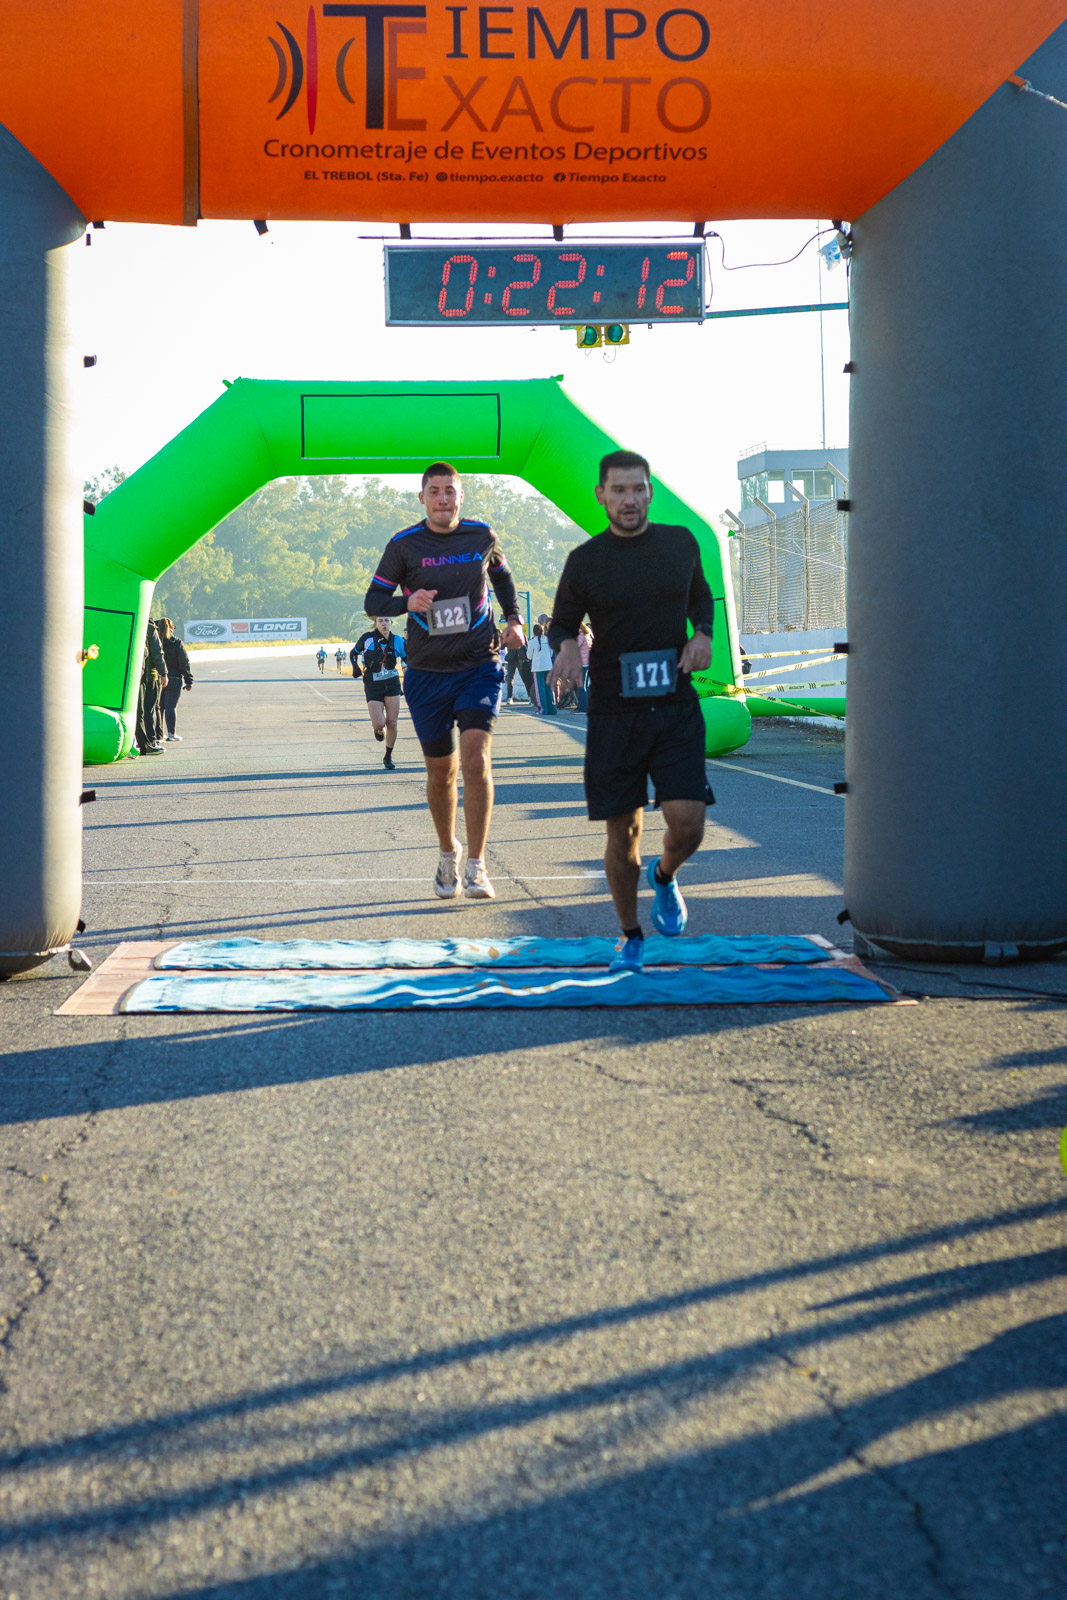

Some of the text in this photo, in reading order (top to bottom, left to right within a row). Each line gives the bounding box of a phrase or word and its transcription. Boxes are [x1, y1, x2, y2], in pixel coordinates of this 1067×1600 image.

[264, 139, 708, 164] Cronometraje de Eventos Deportivos
[304, 170, 319, 180] EL
[322, 170, 374, 180] TREBOL
[376, 171, 406, 182] (Sta.
[409, 171, 429, 182] Fe)
[568, 172, 619, 184] Tiempo
[622, 173, 667, 183] Exacto
[438, 251, 696, 317] 0:22:12
[422, 552, 483, 568] RUNNEA
[434, 606, 465, 628] 122
[195, 622, 298, 636] Ford LONG
[635, 660, 671, 688] 171
